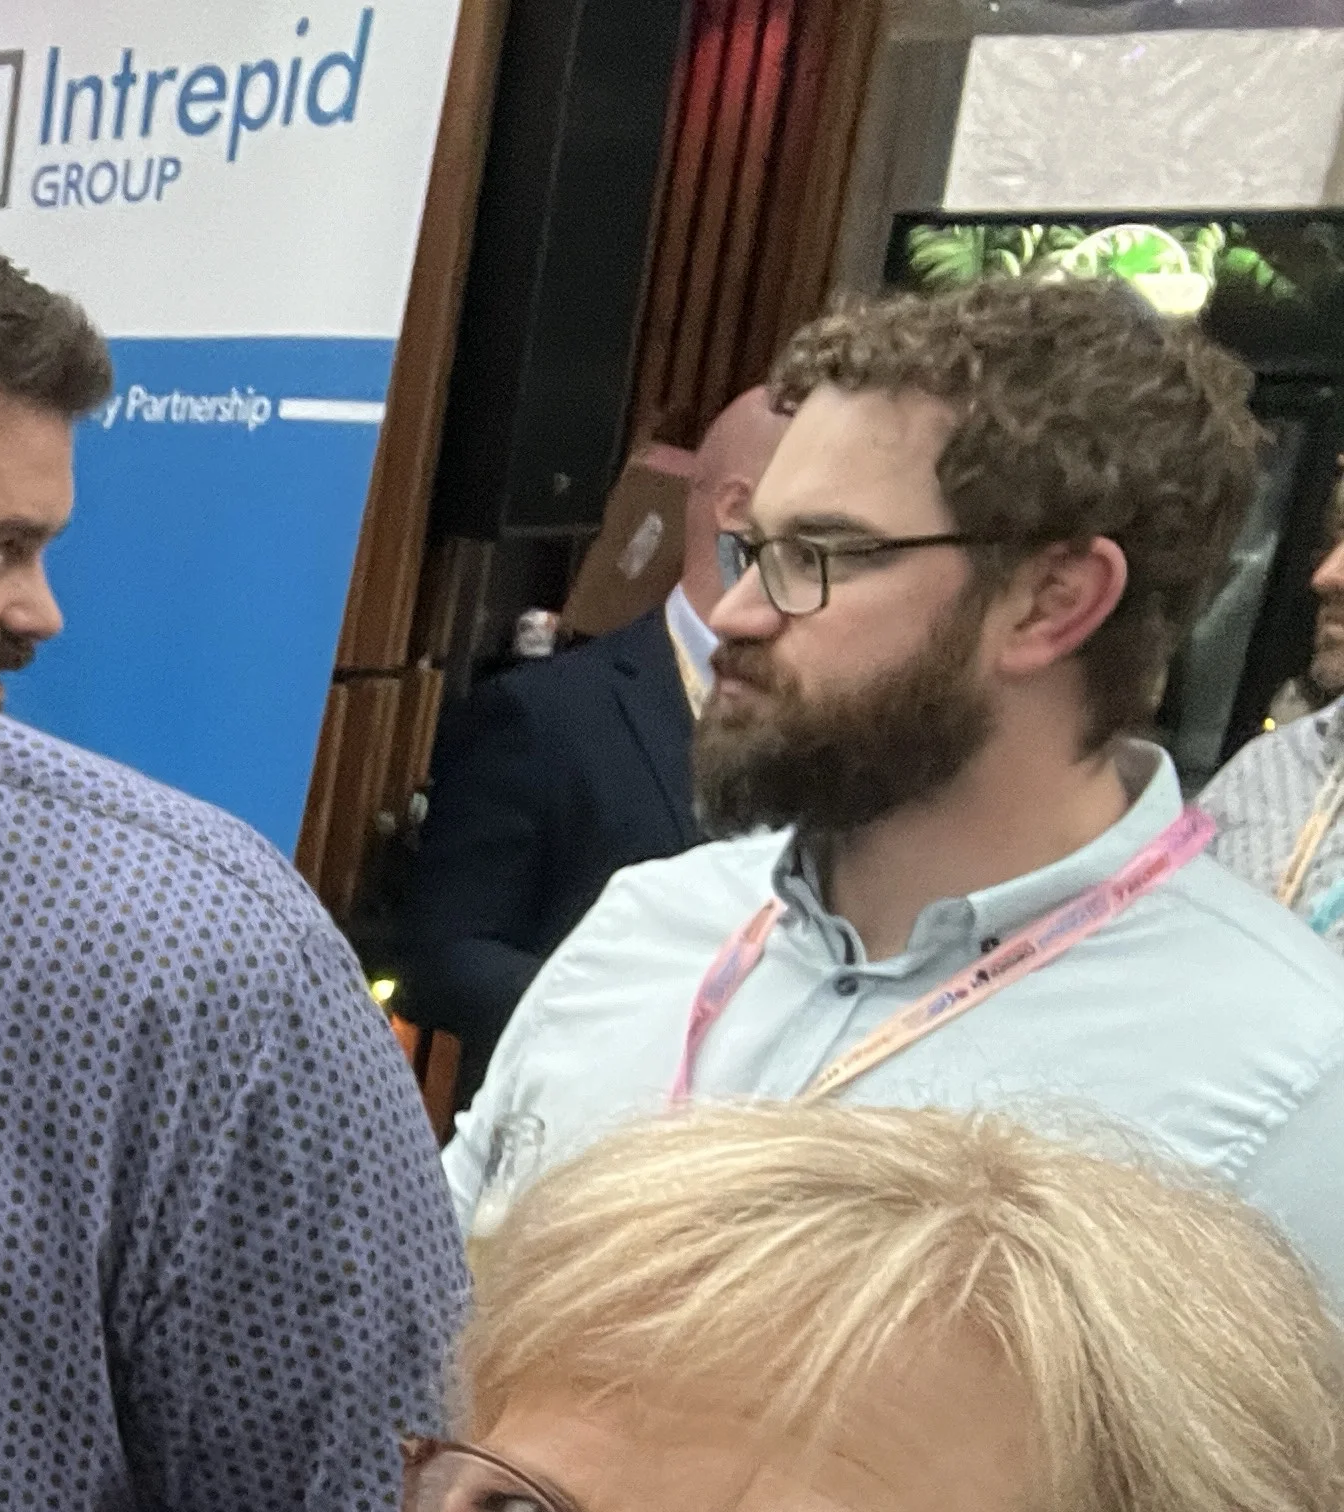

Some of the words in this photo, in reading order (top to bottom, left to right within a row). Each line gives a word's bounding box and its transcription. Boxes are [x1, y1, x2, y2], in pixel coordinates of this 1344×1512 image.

[39, 6, 375, 163] Intrepid
[31, 155, 182, 209] GROUP
[125, 384, 272, 432] Partnership
